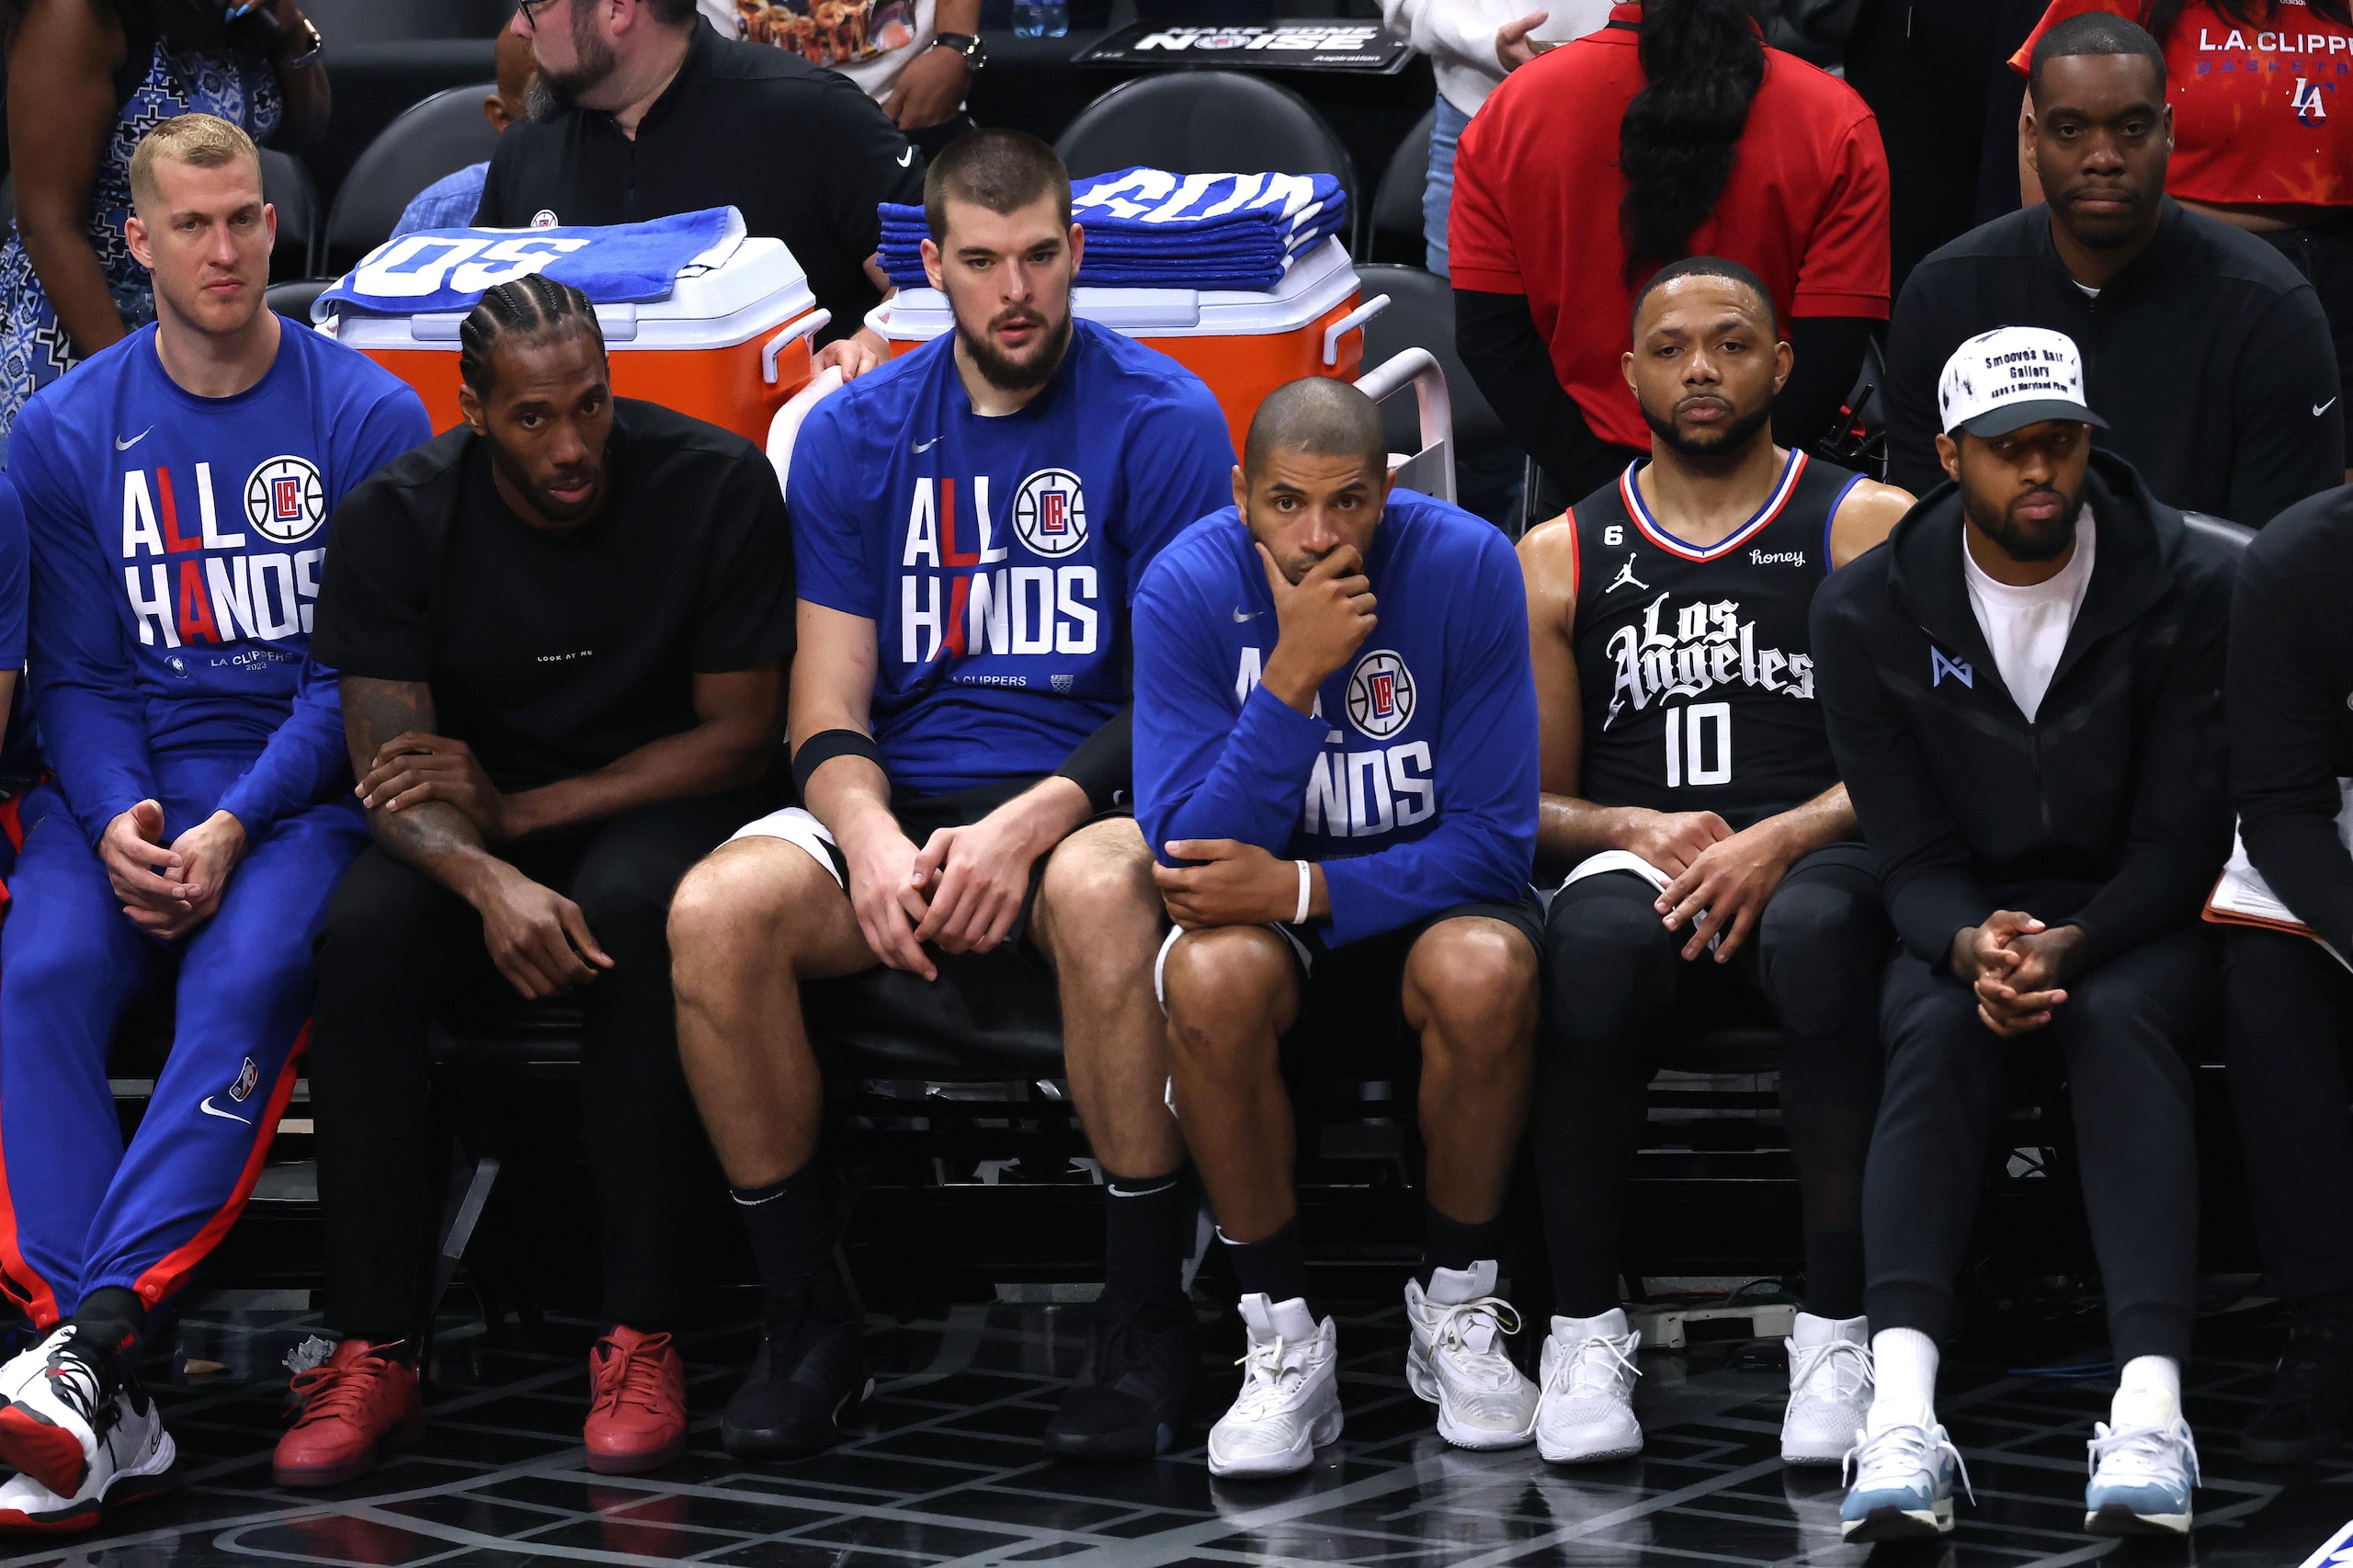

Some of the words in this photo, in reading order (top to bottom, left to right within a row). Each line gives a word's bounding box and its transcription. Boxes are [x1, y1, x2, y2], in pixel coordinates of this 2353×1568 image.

[1165, 27, 1269, 35] MAKE
[1275, 27, 1378, 35] SOME
[2199, 28, 2252, 51] L.A.
[2257, 31, 2353, 56] CLIPP
[2196, 60, 2350, 75] BASKETB
[2042, 349, 2063, 363] Hair
[2009, 365, 2050, 379] Gallery
[2018, 381, 2052, 392] Maryland
[122, 461, 246, 558] ALL
[903, 476, 1008, 568] ALL
[1603, 525, 1623, 546] 6
[1749, 549, 1806, 567] honey
[124, 547, 327, 649] HANDS
[902, 565, 1098, 663] HANDS
[1639, 591, 1740, 653] Los
[210, 658, 229, 667] LA
[232, 650, 294, 665] CLIPPERS
[245, 662, 267, 671] 2023
[1603, 620, 1815, 733] Angeles
[1665, 701, 1732, 788] 10
[1304, 741, 1436, 837] NDS
